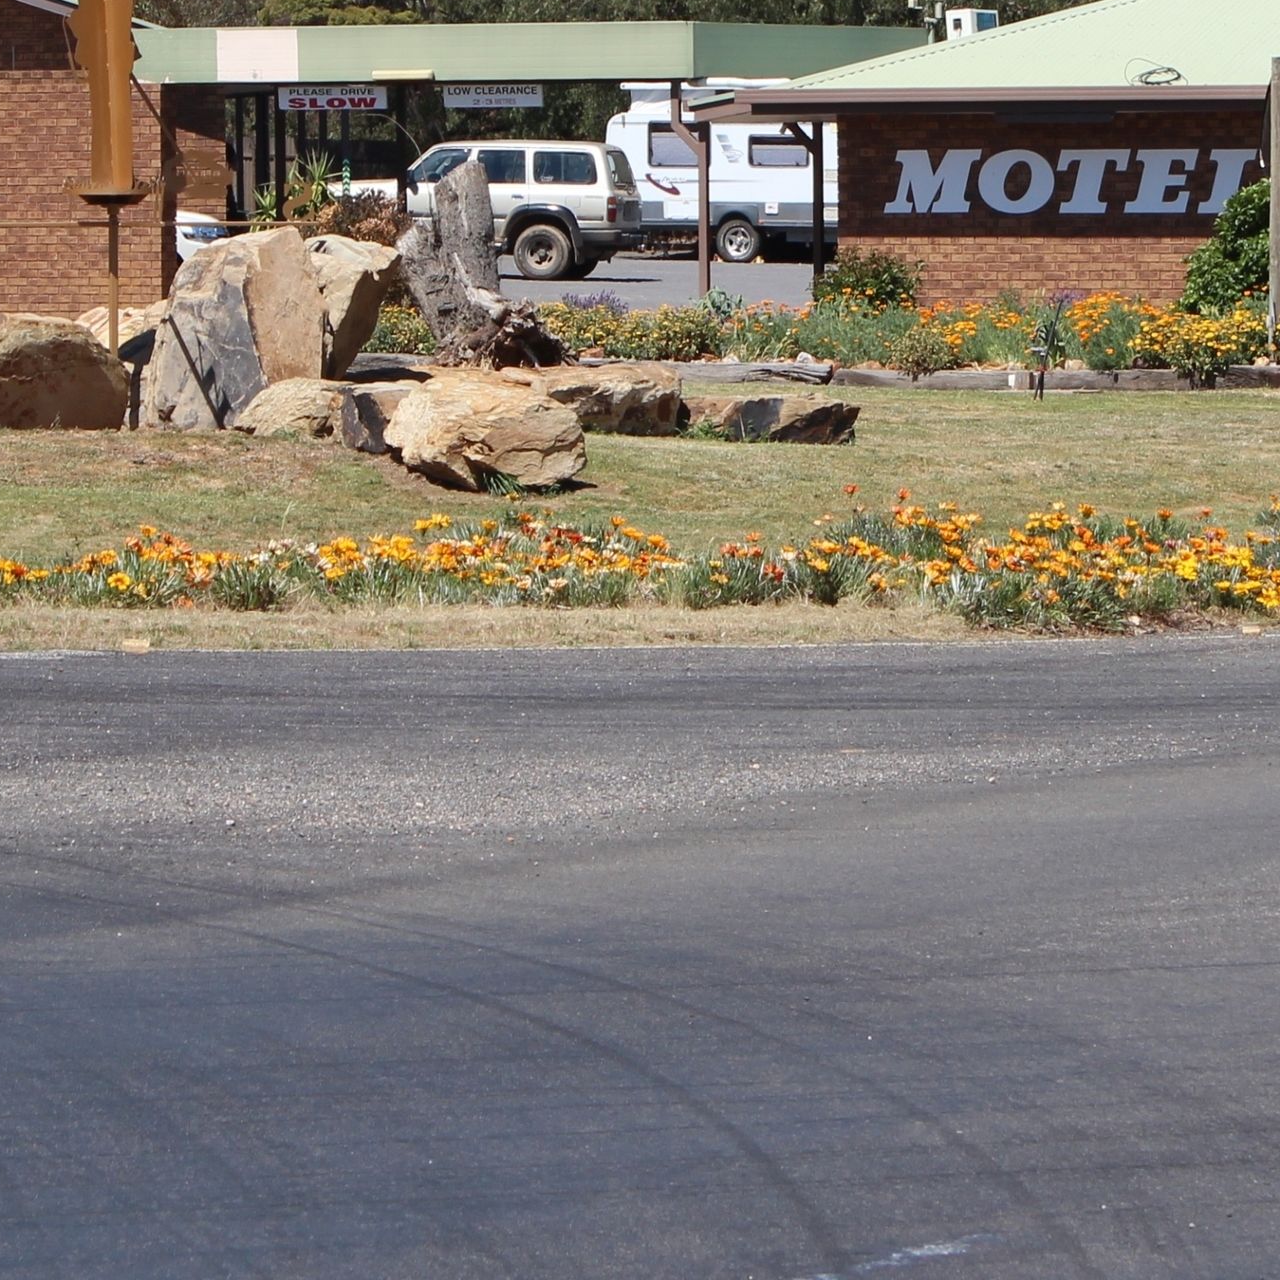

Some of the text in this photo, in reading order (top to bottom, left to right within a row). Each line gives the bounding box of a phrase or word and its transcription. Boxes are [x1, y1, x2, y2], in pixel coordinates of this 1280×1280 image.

[289, 87, 375, 96] PLEASE DRIVE
[447, 86, 538, 95] LOW CLEARANCE
[288, 97, 377, 108] SLOW
